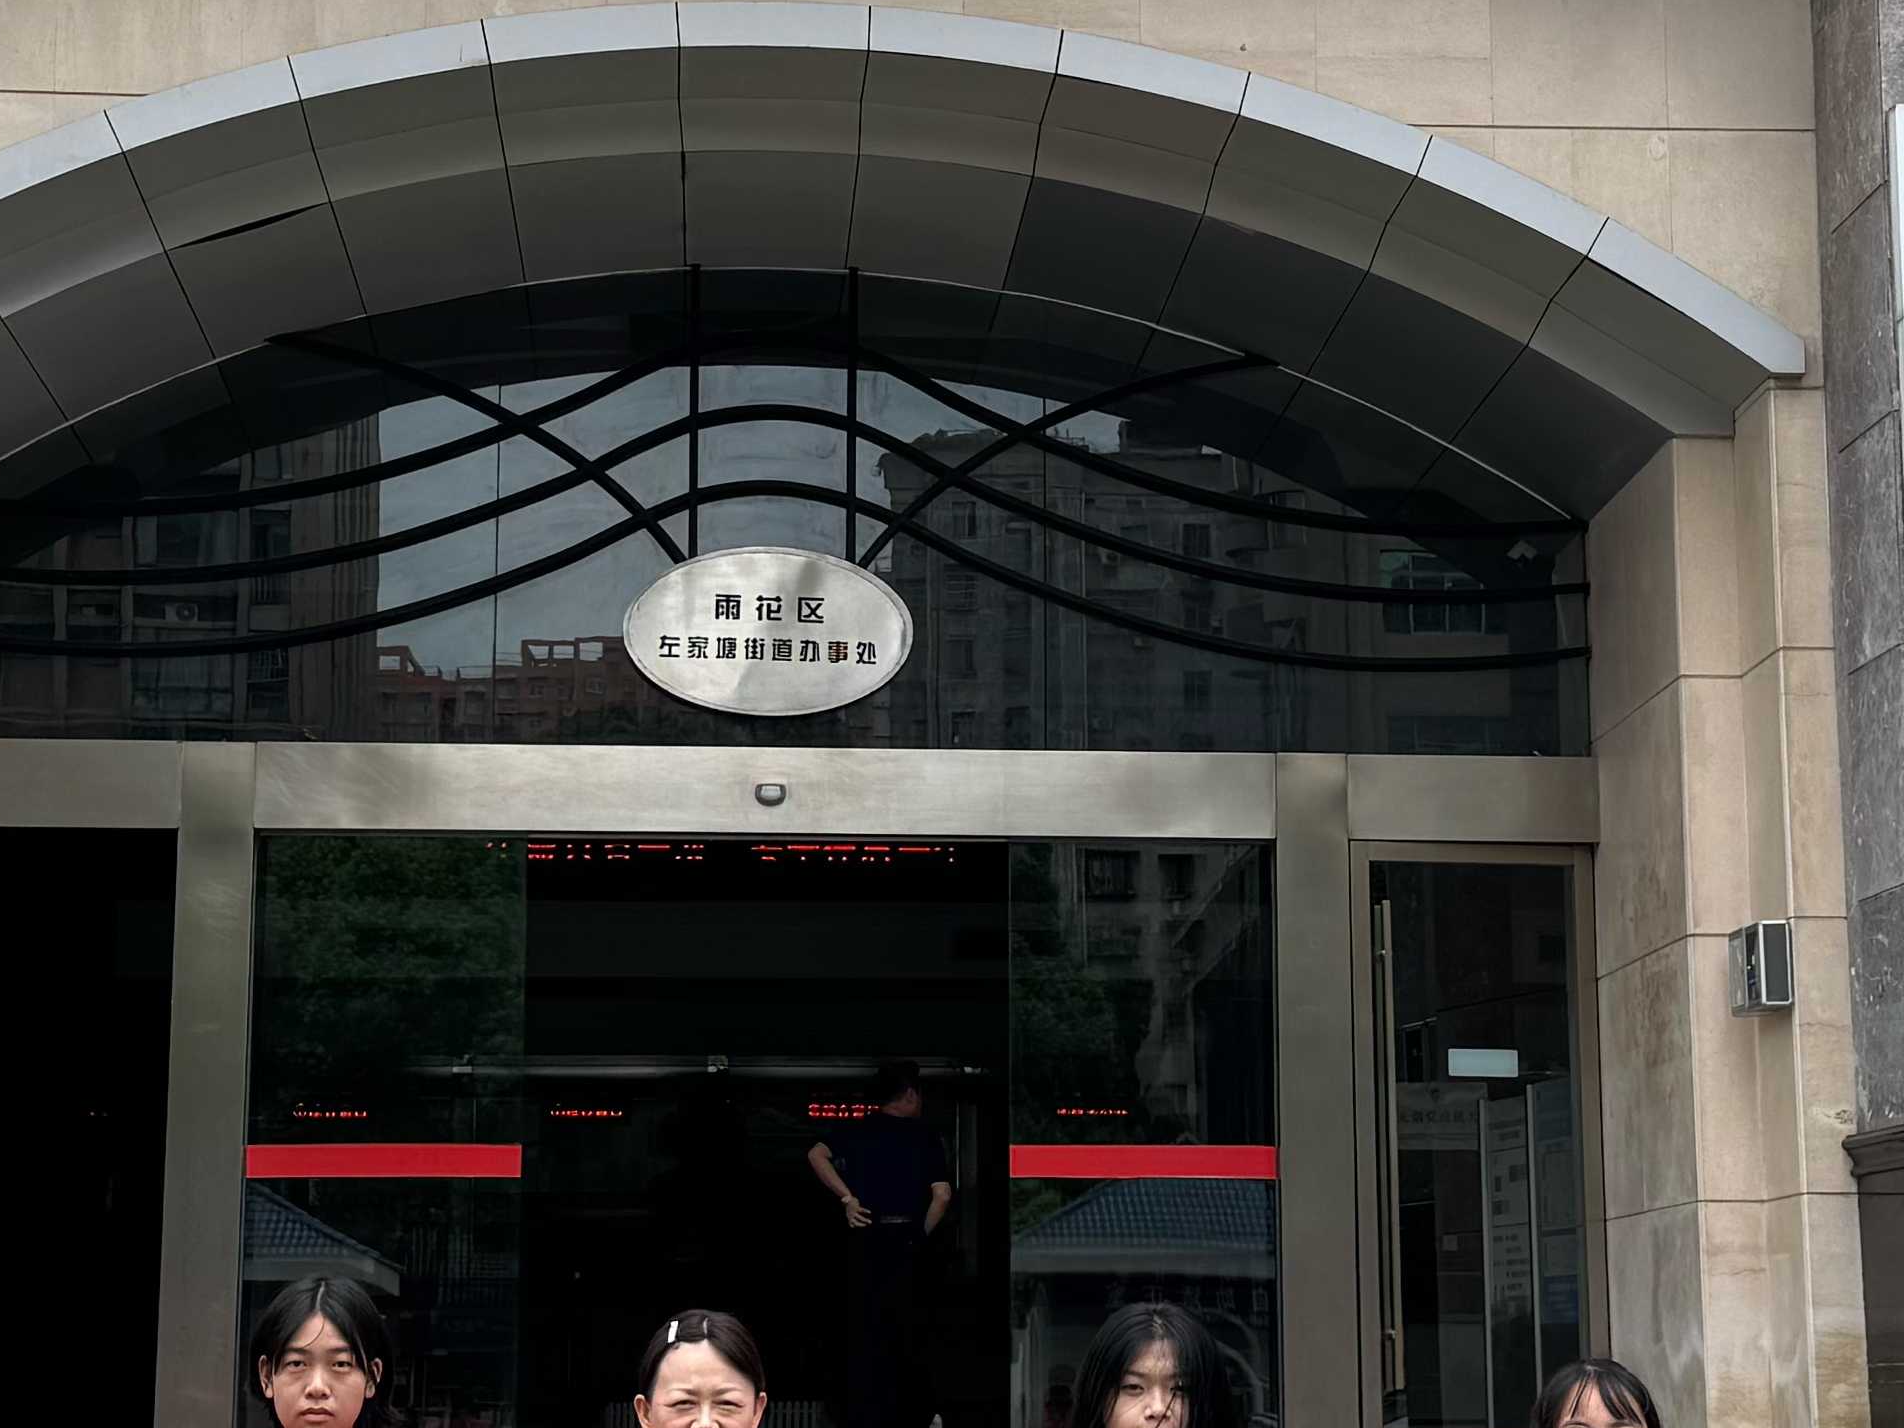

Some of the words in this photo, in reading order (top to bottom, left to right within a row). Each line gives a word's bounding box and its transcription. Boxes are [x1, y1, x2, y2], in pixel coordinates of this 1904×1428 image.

[715, 593, 826, 624] 雨花区
[658, 634, 878, 665] 左家塘街道办事处
